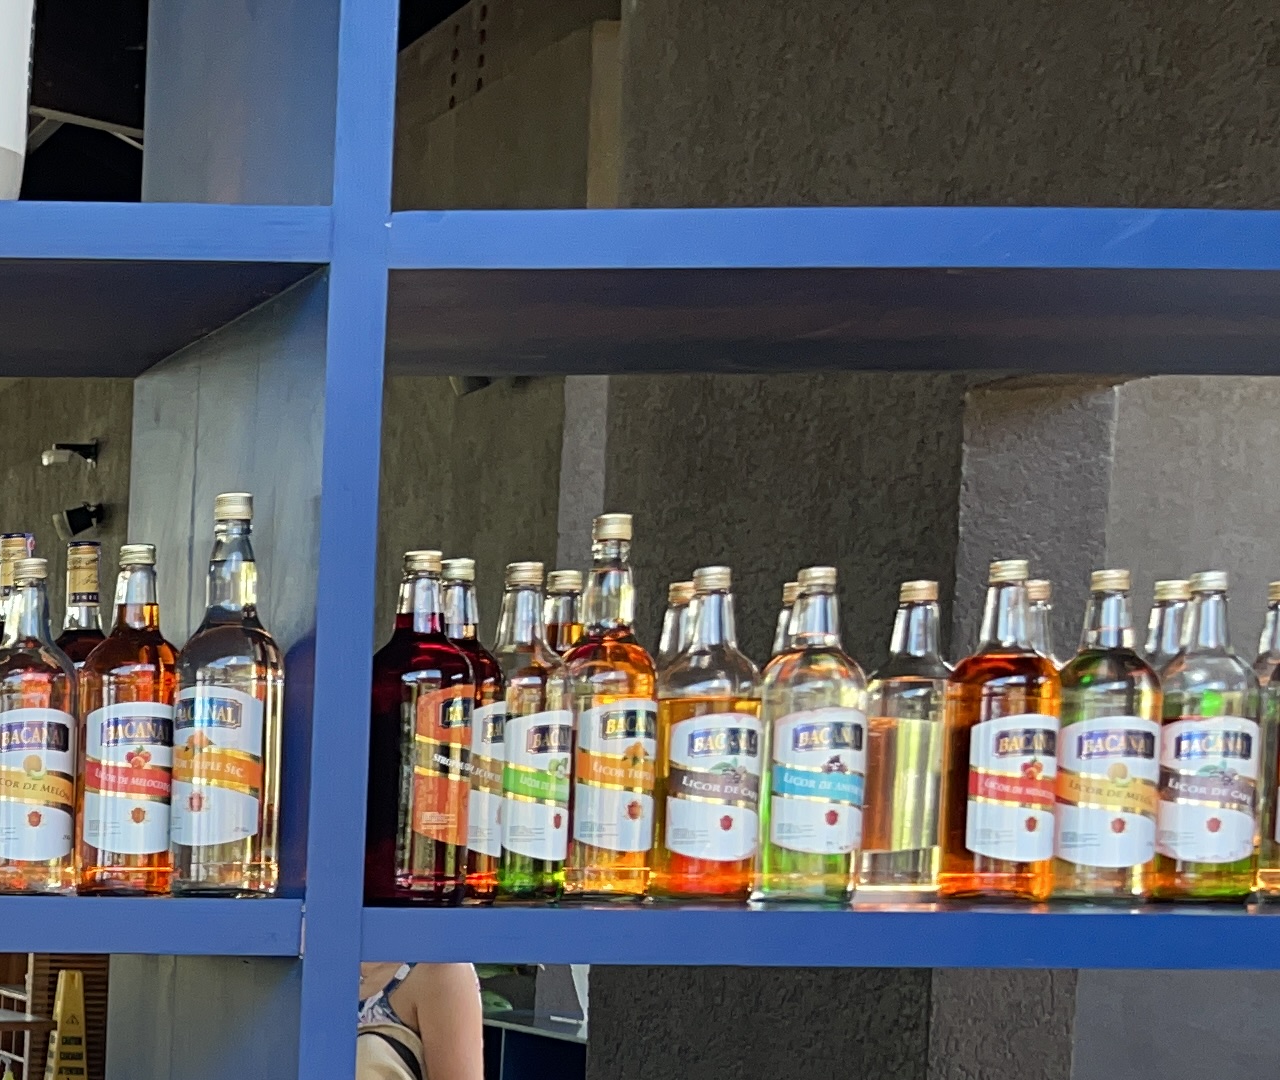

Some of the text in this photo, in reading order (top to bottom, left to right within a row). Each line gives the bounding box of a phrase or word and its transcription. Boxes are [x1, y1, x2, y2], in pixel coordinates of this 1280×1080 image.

[95, 769, 116, 784] LICOR
[223, 763, 244, 778] SEC
[593, 761, 625, 780] LICOR
[23, 781, 38, 791] DE
[682, 775, 739, 795] LICOR DE
[783, 773, 816, 789] LICOR
[1068, 780, 1103, 797] LICOR
[1168, 778, 1227, 798] LICOR DE
